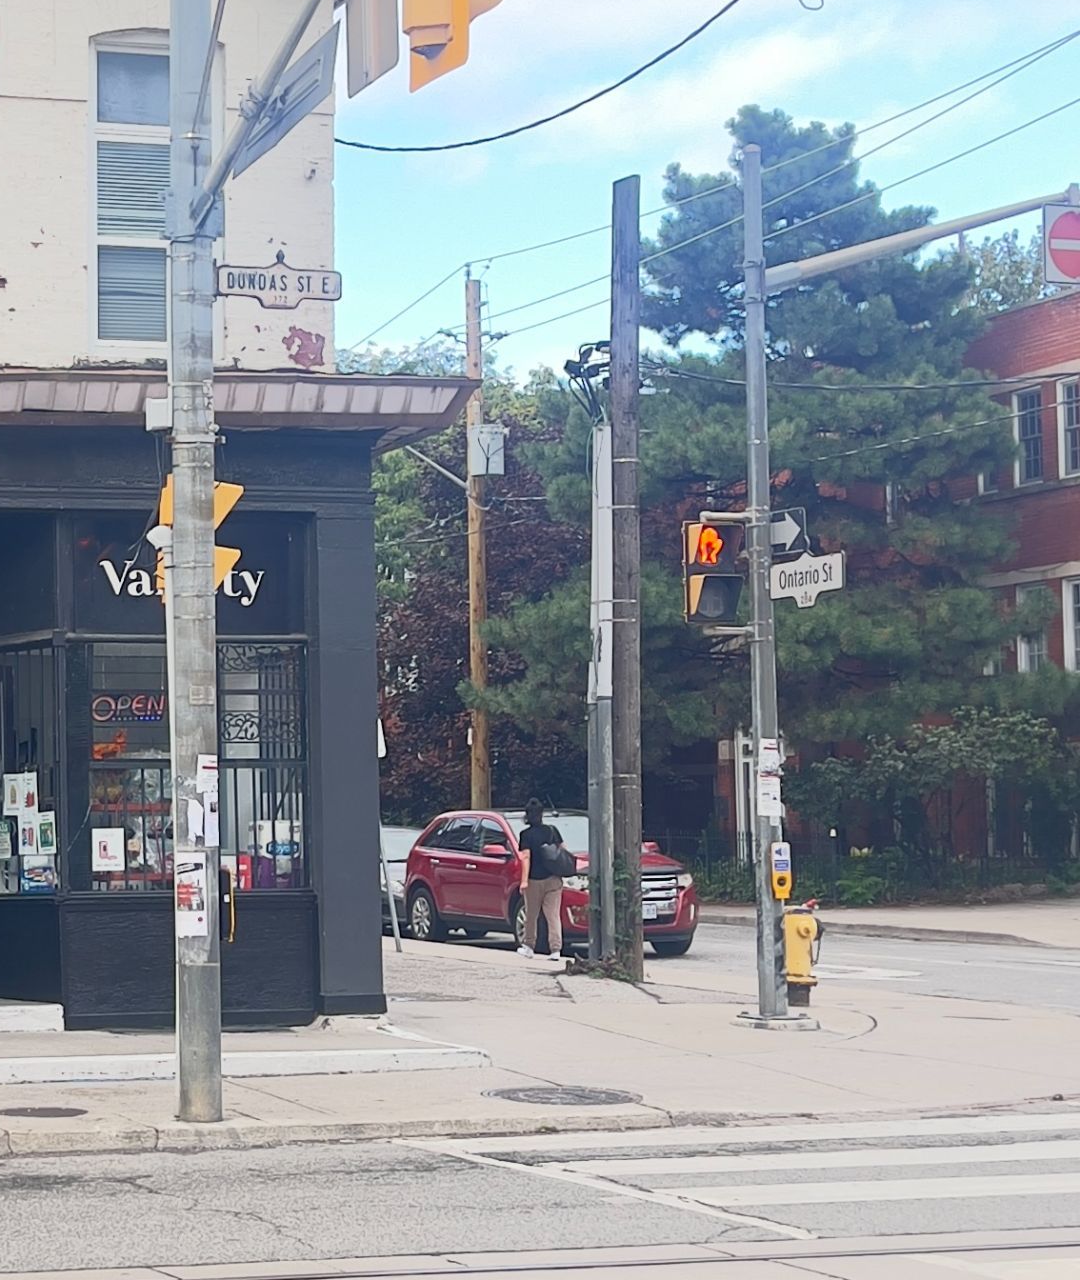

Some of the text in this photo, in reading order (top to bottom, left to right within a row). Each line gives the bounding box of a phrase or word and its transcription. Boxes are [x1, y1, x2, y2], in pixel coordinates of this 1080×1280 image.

[226, 271, 288, 292] DUNDAS
[99, 560, 265, 606] Vaty
[778, 562, 833, 590] Ontario St
[92, 695, 166, 721] OPEN
